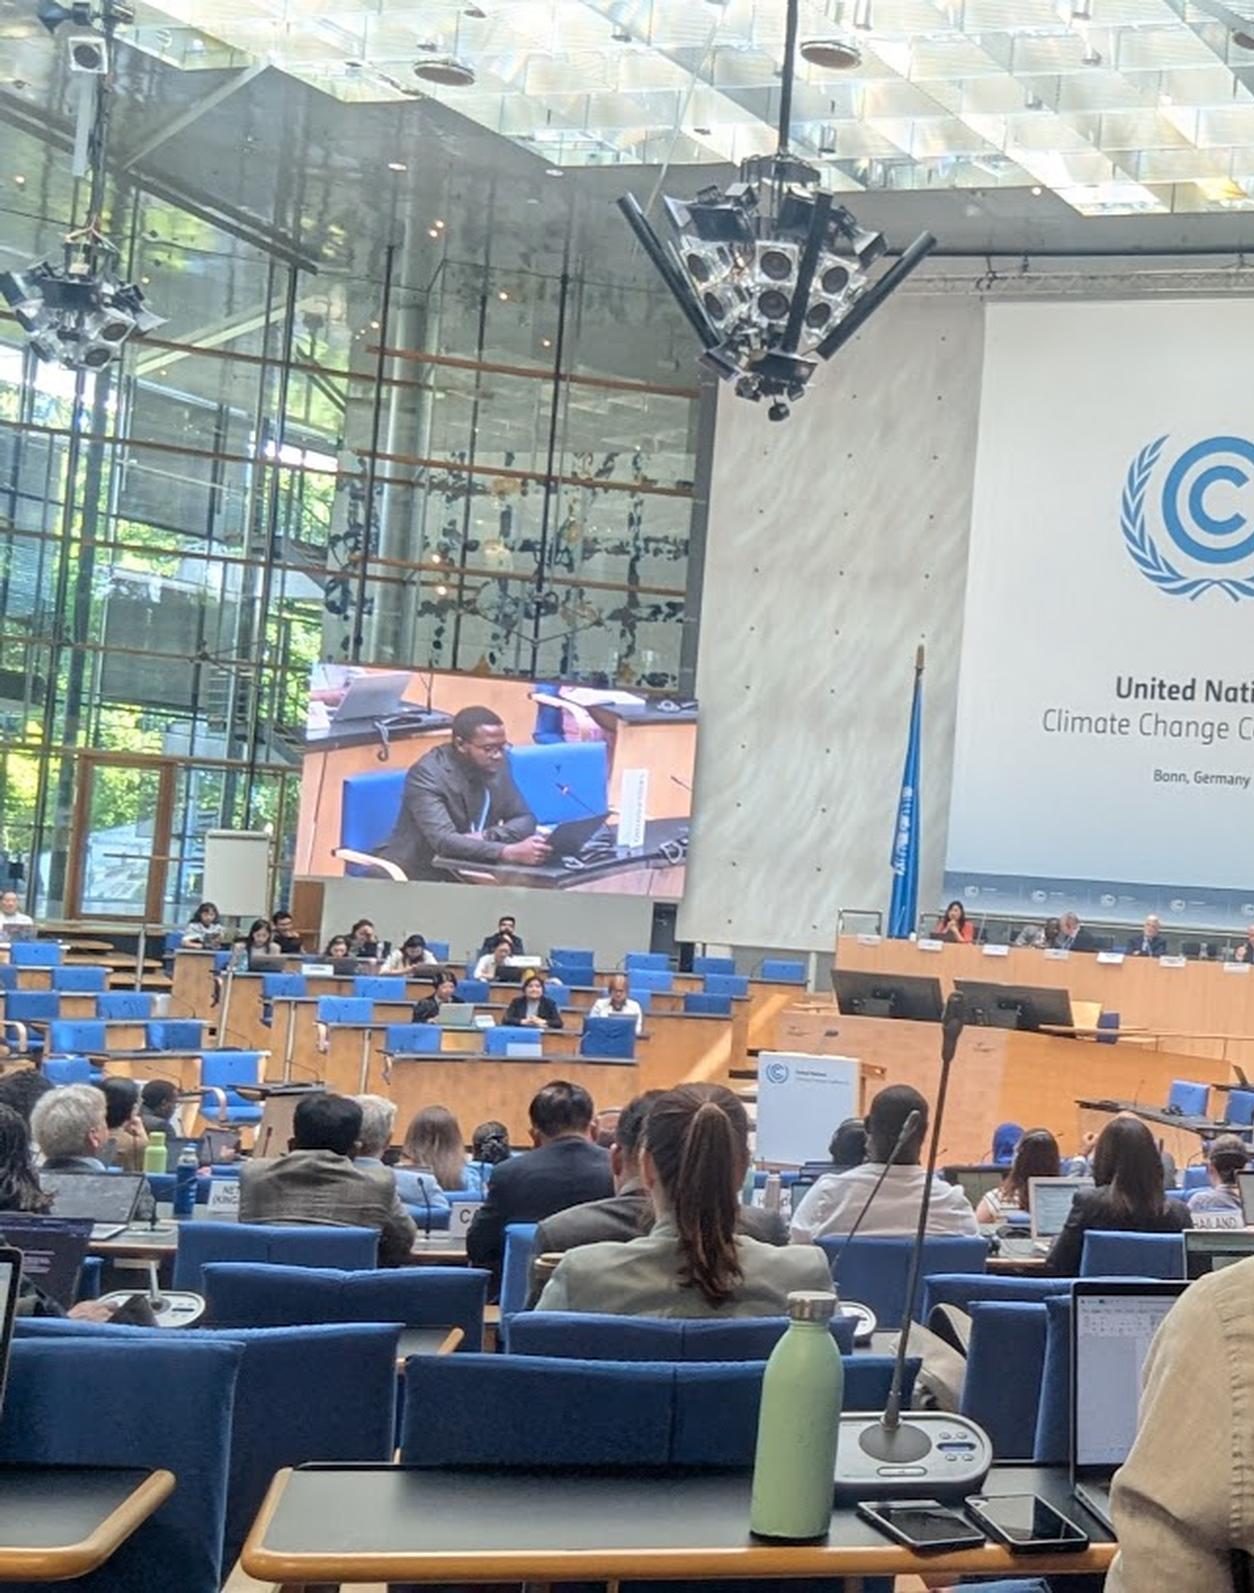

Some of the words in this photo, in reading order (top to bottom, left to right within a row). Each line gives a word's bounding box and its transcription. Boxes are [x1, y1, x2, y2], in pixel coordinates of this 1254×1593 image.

[1115, 675, 1197, 702] United
[1042, 708, 1131, 736] Climate
[1138, 711, 1230, 746] Change
[1153, 768, 1190, 785] Bonn,
[1193, 770, 1252, 790] Germany
